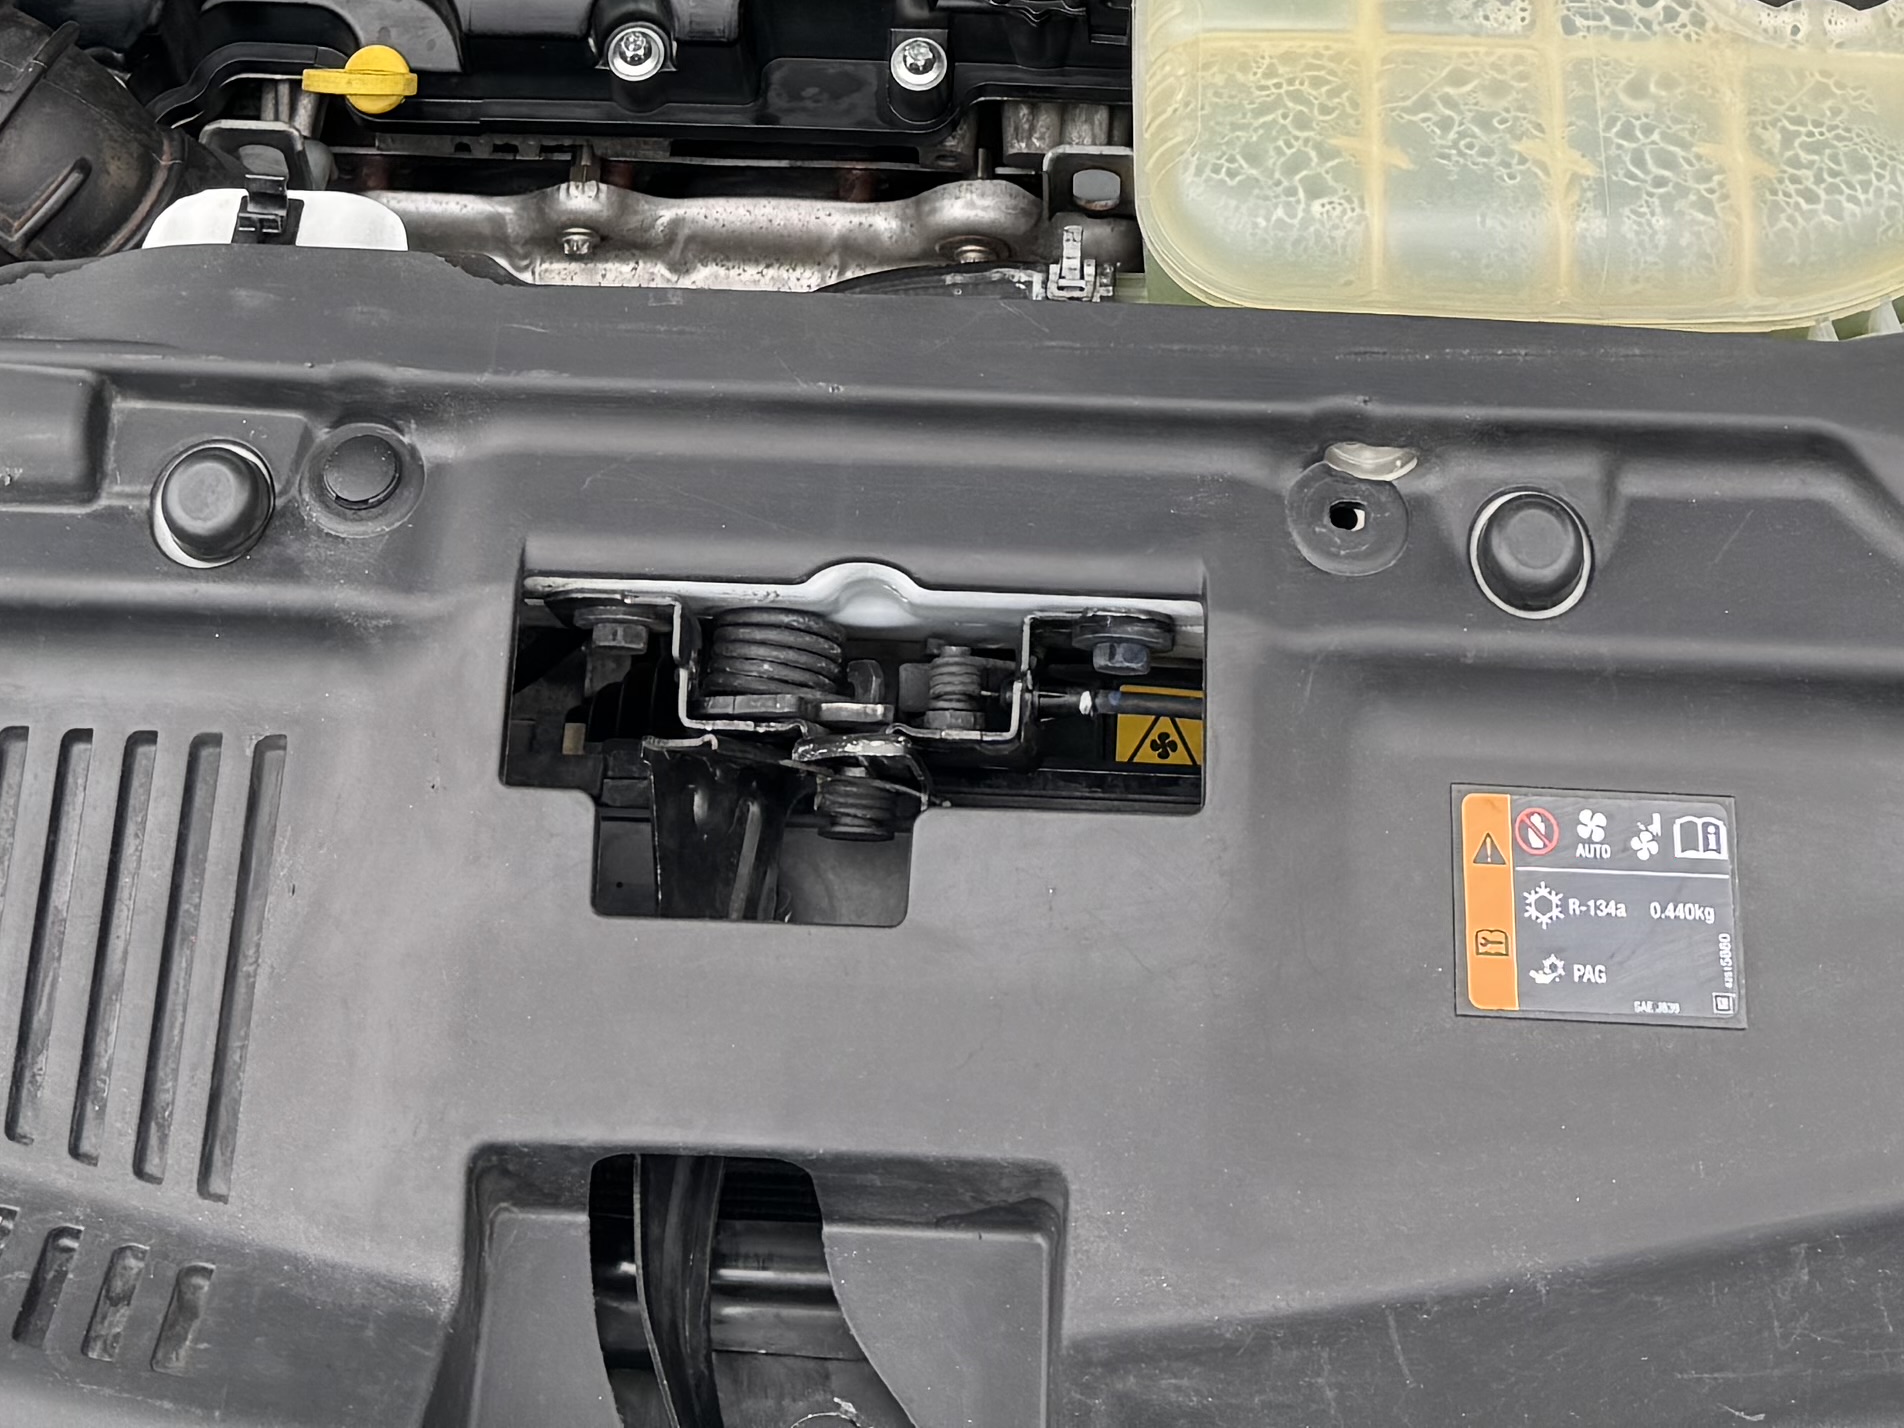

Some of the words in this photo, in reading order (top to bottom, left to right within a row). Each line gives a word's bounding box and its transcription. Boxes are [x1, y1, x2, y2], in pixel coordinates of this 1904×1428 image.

[1575, 843, 1611, 859] AUTO
[1568, 897, 1627, 918] R-134a
[1649, 903, 1715, 924] 0.440kg
[1573, 965, 1607, 983] PAG
